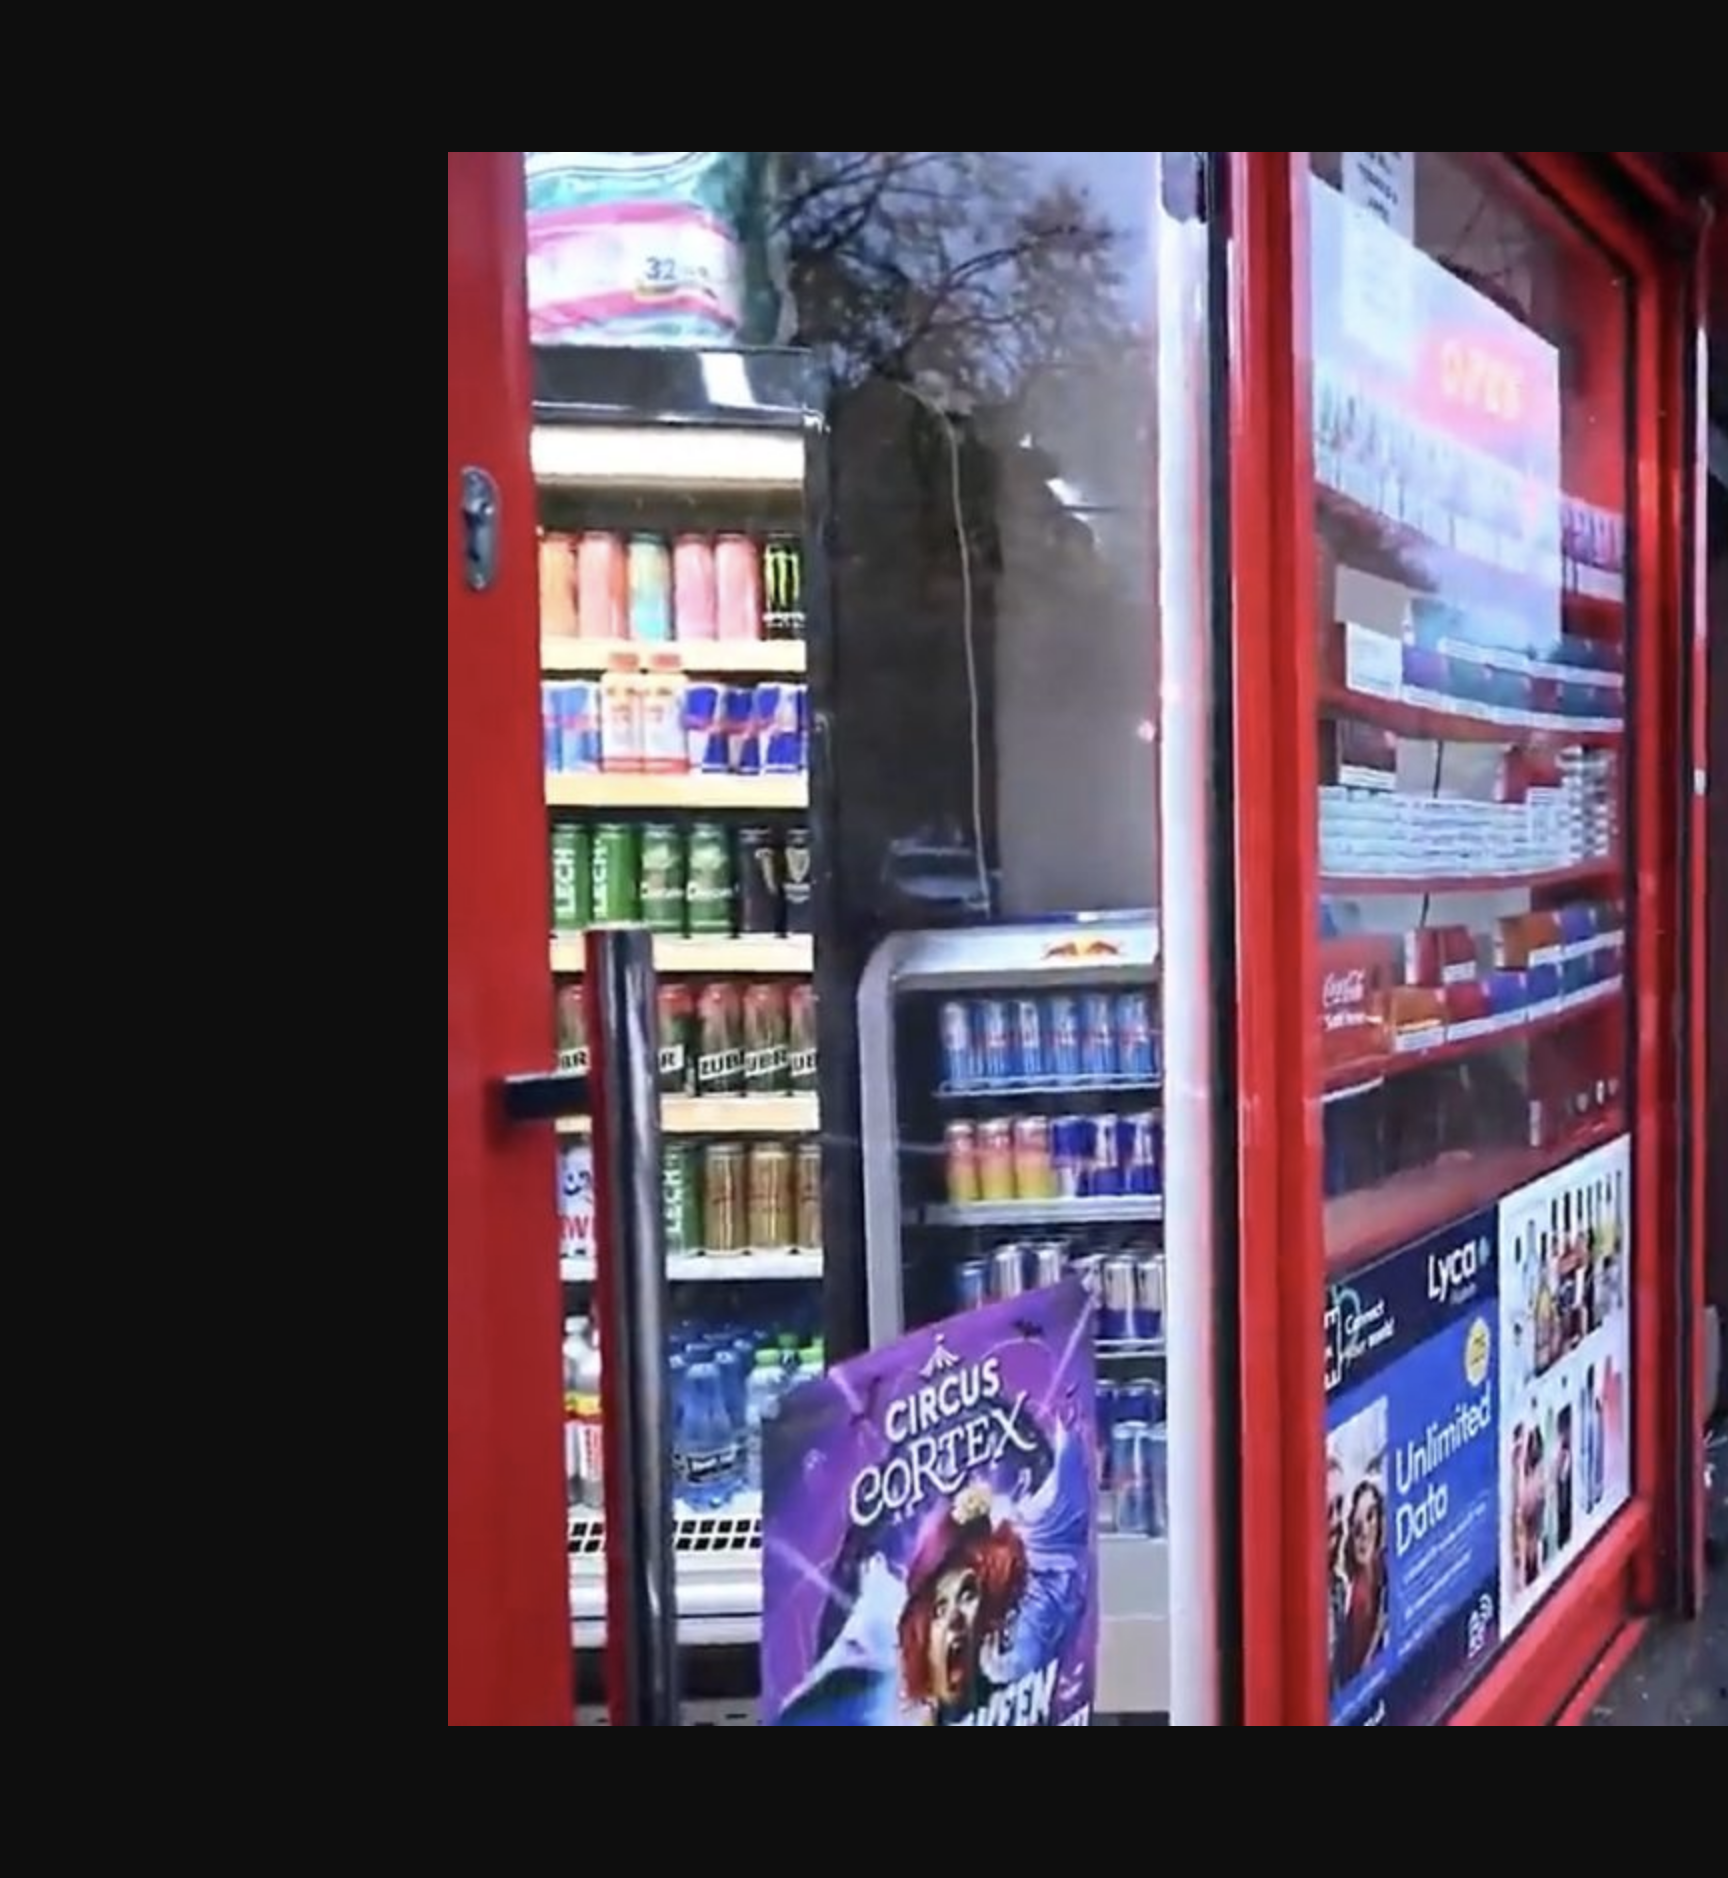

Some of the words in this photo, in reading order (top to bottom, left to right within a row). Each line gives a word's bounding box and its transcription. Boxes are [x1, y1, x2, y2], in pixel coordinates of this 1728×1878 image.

[645, 256, 676, 281] 32
[553, 846, 576, 916] LECH
[1428, 1240, 1477, 1302] Lyca
[885, 1357, 1000, 1443] CIRCUS
[1396, 1379, 1491, 1495] Unlimited
[850, 1390, 1038, 1527] CORTEX
[1396, 1483, 1447, 1557] Data
